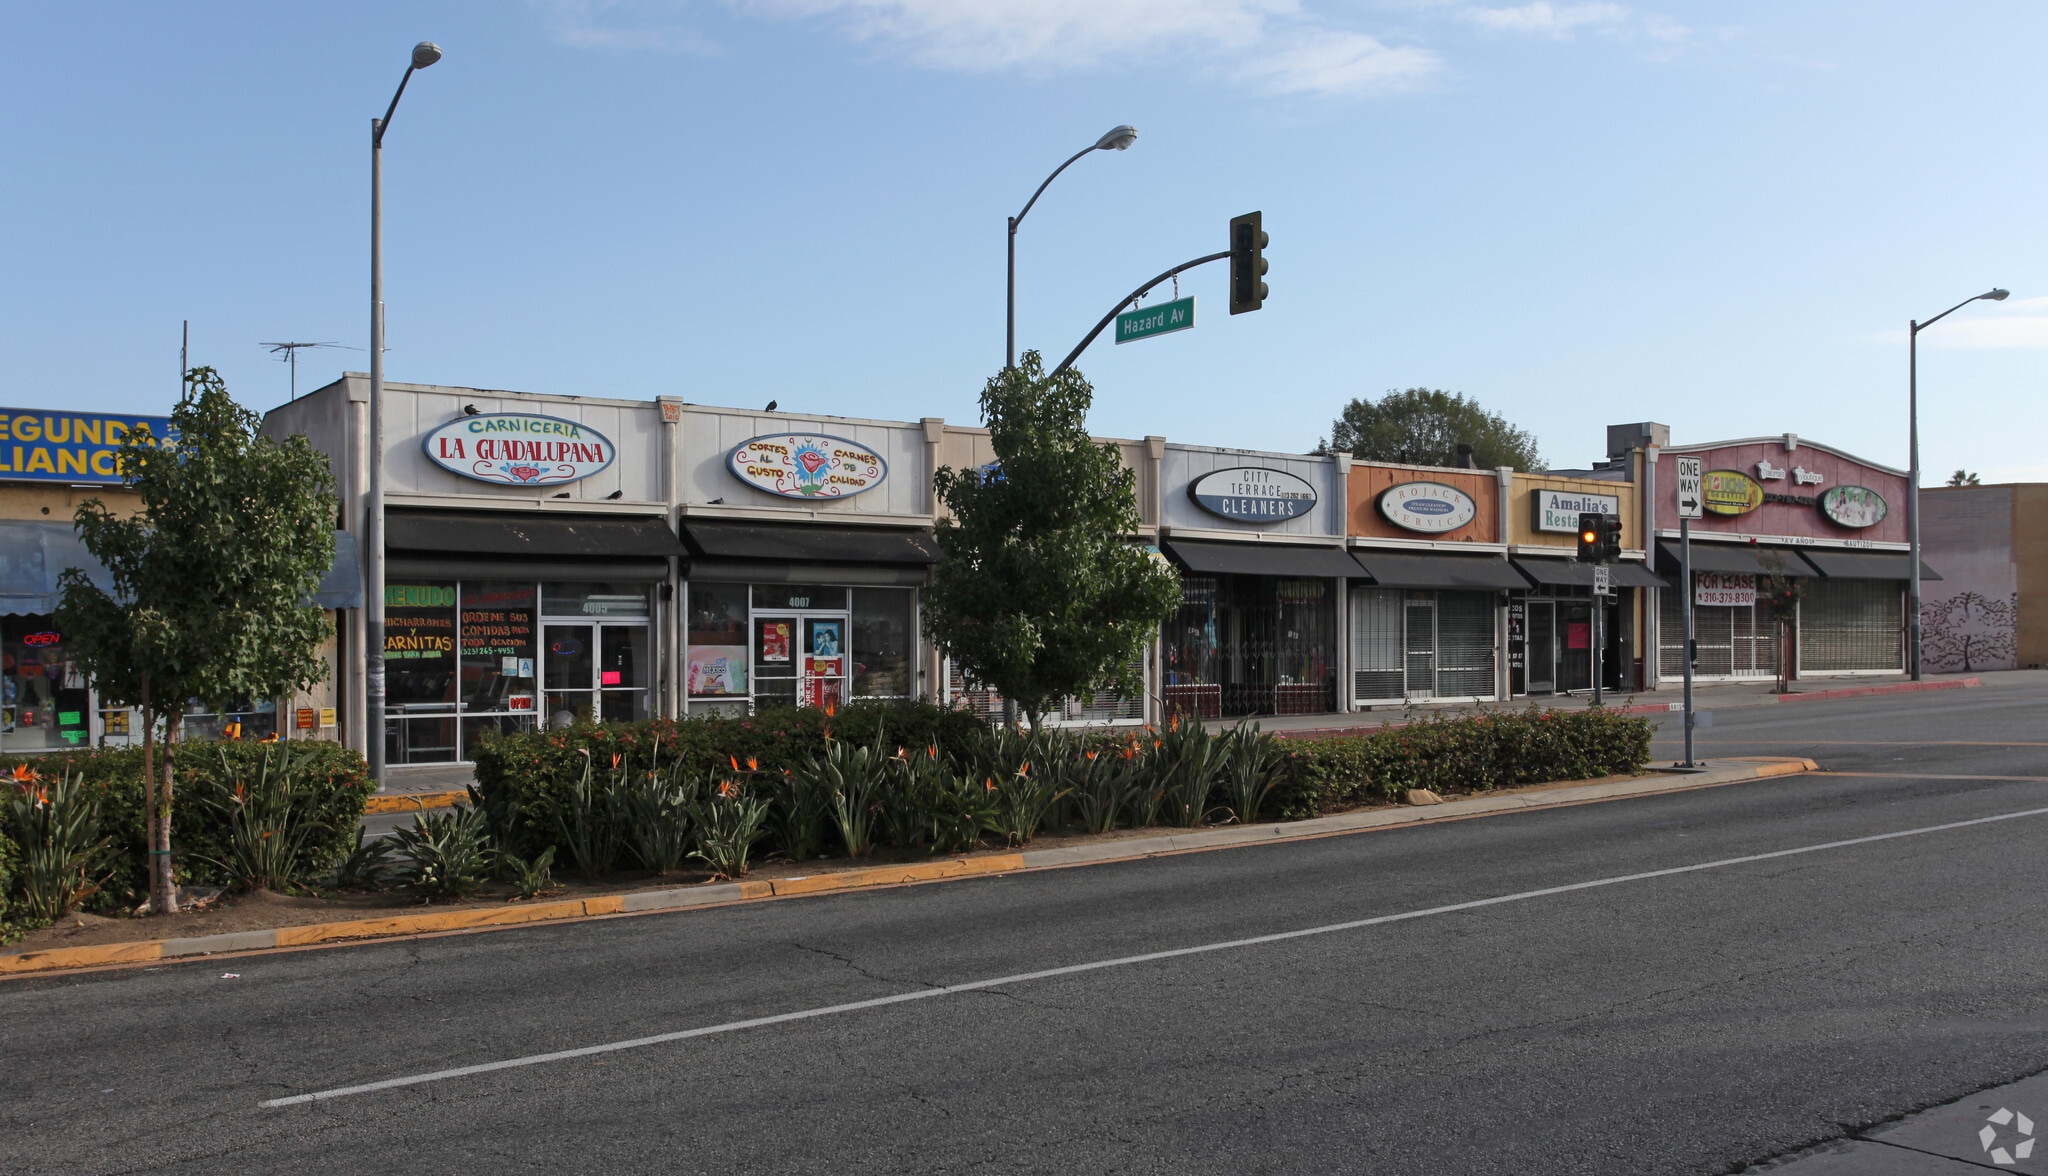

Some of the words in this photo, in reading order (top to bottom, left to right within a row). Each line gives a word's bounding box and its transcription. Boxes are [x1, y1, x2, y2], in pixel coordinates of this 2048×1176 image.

[1124, 312, 1164, 335] Hazard
[1170, 308, 1184, 324] Av
[468, 418, 581, 440] CARNICERIA
[439, 437, 467, 459] LA
[476, 439, 605, 463] GUADALUPANA
[748, 443, 788, 455] CORTES
[760, 454, 773, 464] AL
[834, 449, 877, 465] CARNES
[747, 465, 784, 478] GUSTO
[843, 463, 857, 472] DE
[1680, 461, 1699, 476] ONE
[829, 475, 866, 486] CALIDAD
[1243, 470, 1269, 483] CITY
[1231, 483, 1281, 496] TERRACE
[1680, 479, 1699, 493] WAY
[1399, 487, 1461, 504] ROJACK
[1222, 498, 1294, 516] CLEANERS
[1549, 494, 1609, 514] Amalia's
[1393, 510, 1466, 528] SERVICE
[1545, 510, 1579, 528] Resta
[1595, 568, 1608, 576] ONE
[1697, 573, 1718, 589] FOR
[1722, 574, 1755, 590] LEASE
[384, 585, 456, 607] MENUDO
[789, 597, 810, 607] 4007
[583, 602, 607, 613] 4005
[462, 611, 505, 624] ORDENE
[509, 612, 528, 622] SUS
[462, 626, 510, 636] COMIDAS
[24, 633, 60, 645] OPEN
[384, 635, 452, 651] ARNITAS
[461, 638, 485, 647] TODA
[522, 661, 530, 671] A
[510, 697, 531, 709] OPEN
